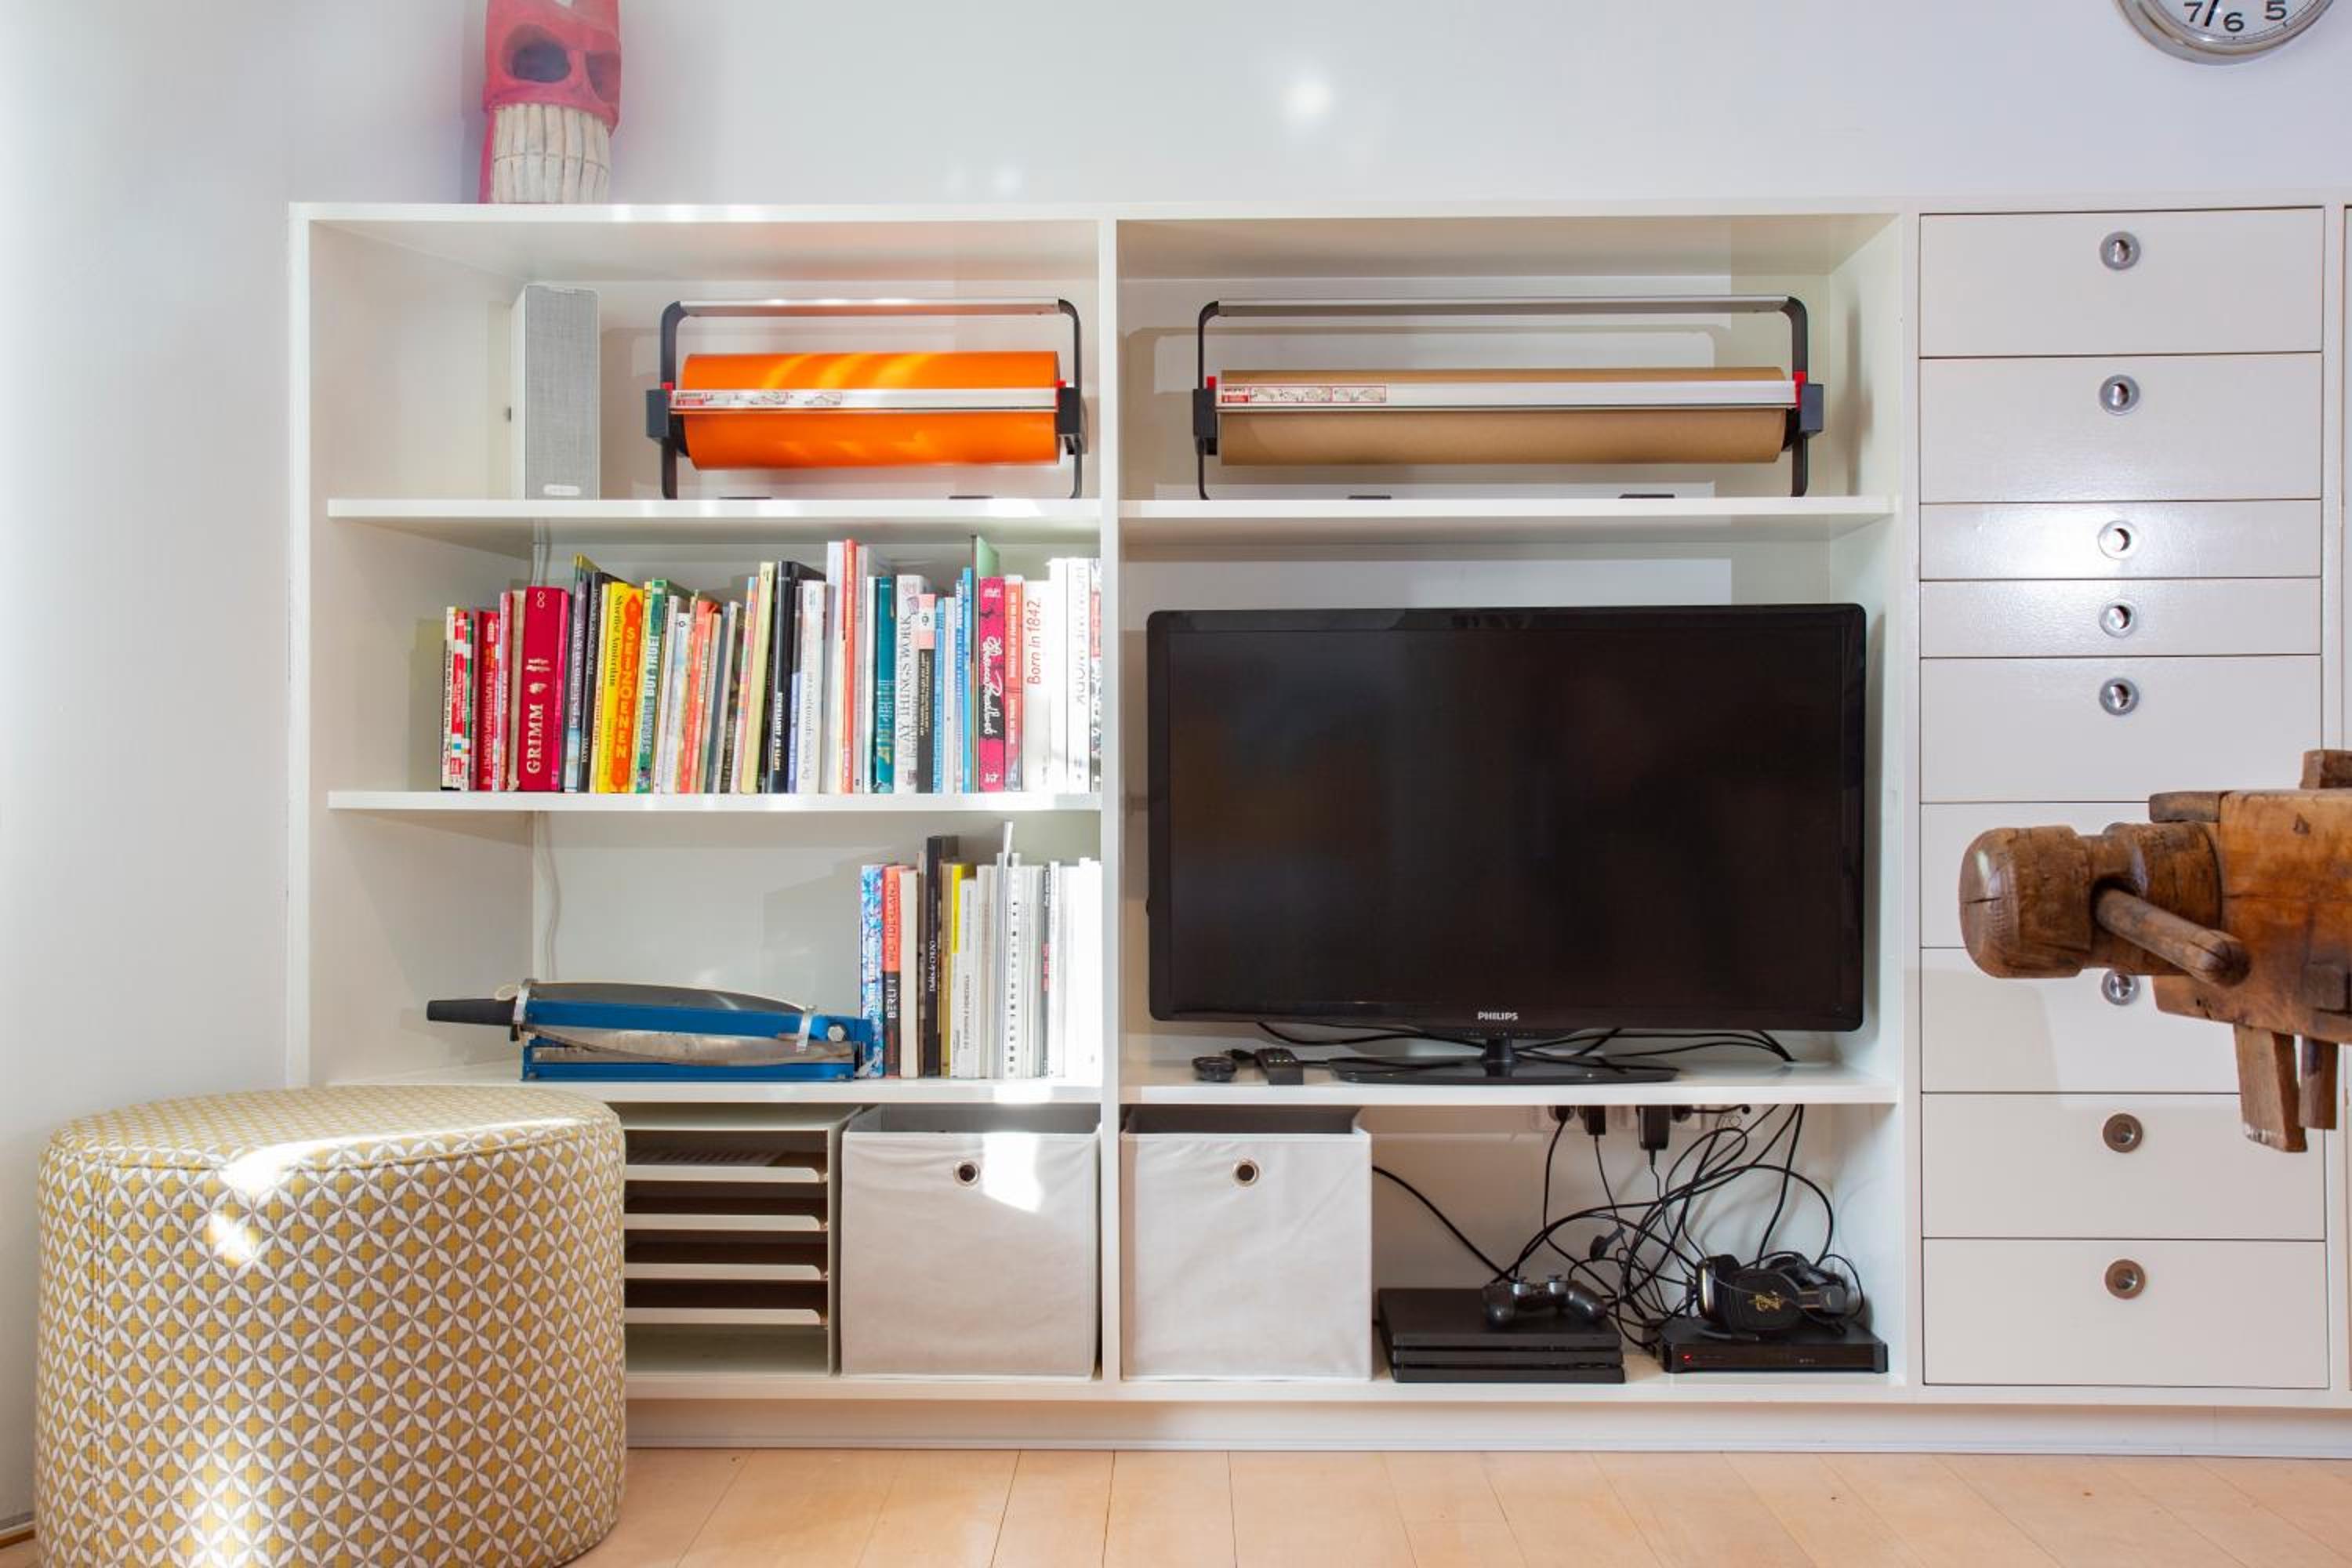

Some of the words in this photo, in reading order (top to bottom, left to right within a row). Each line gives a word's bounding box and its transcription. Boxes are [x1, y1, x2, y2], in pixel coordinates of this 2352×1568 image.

[2183, 2, 2203, 22] 7
[2223, 12, 2245, 32] 6
[2264, 1, 2287, 20] 5
[899, 615, 912, 662] WORK
[645, 635, 660, 670] TRUE!
[1026, 652, 1041, 684] Born
[643, 675, 657, 697] BUT
[898, 663, 911, 717] THINGS
[526, 703, 545, 774] GRIMM
[1478, 1011, 1519, 1021] PHILIPS
